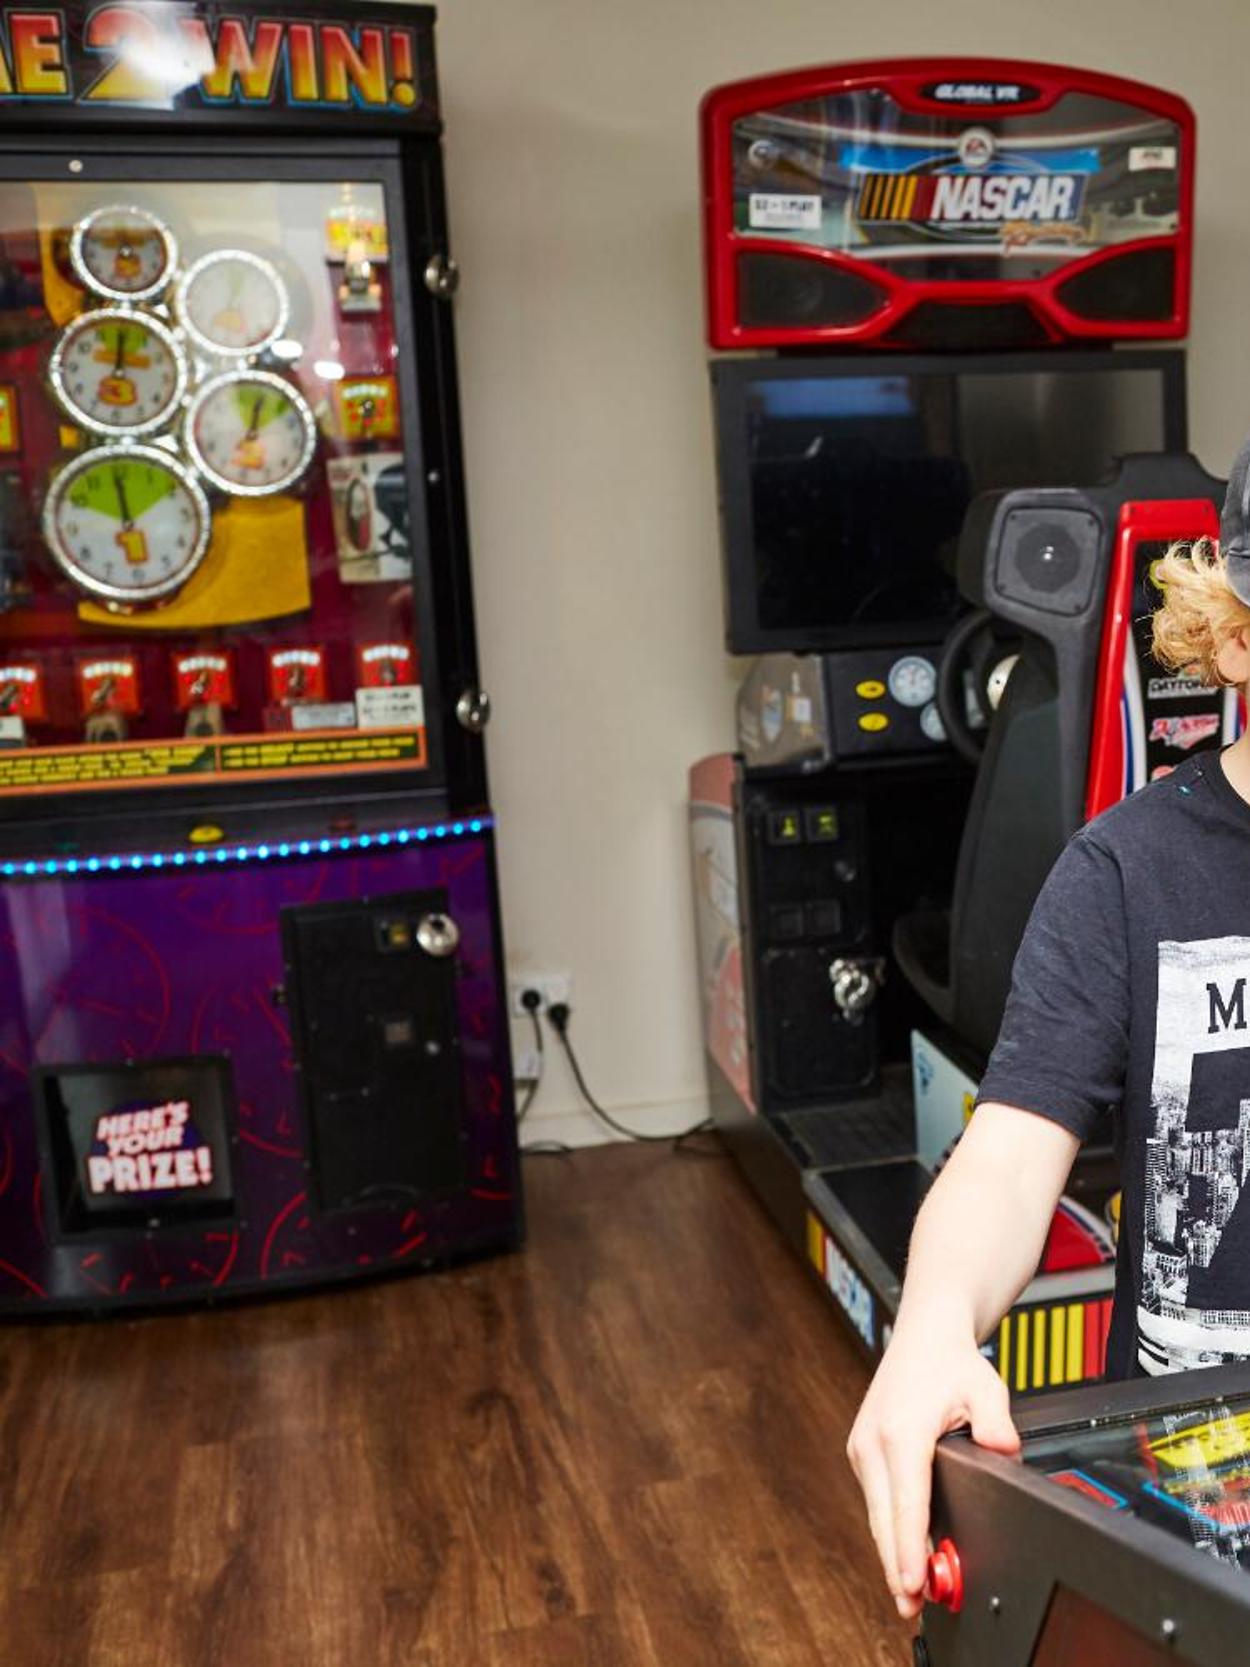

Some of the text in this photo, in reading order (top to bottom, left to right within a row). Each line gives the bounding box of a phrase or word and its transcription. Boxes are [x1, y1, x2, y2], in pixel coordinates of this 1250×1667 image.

[0, 10, 70, 97] E
[178, 17, 416, 107] WIN!
[930, 175, 1075, 221] NASCAR
[97, 1101, 189, 1140] HERE'S
[107, 1124, 184, 1158] YOUR
[88, 1146, 213, 1193] PRIZE!
